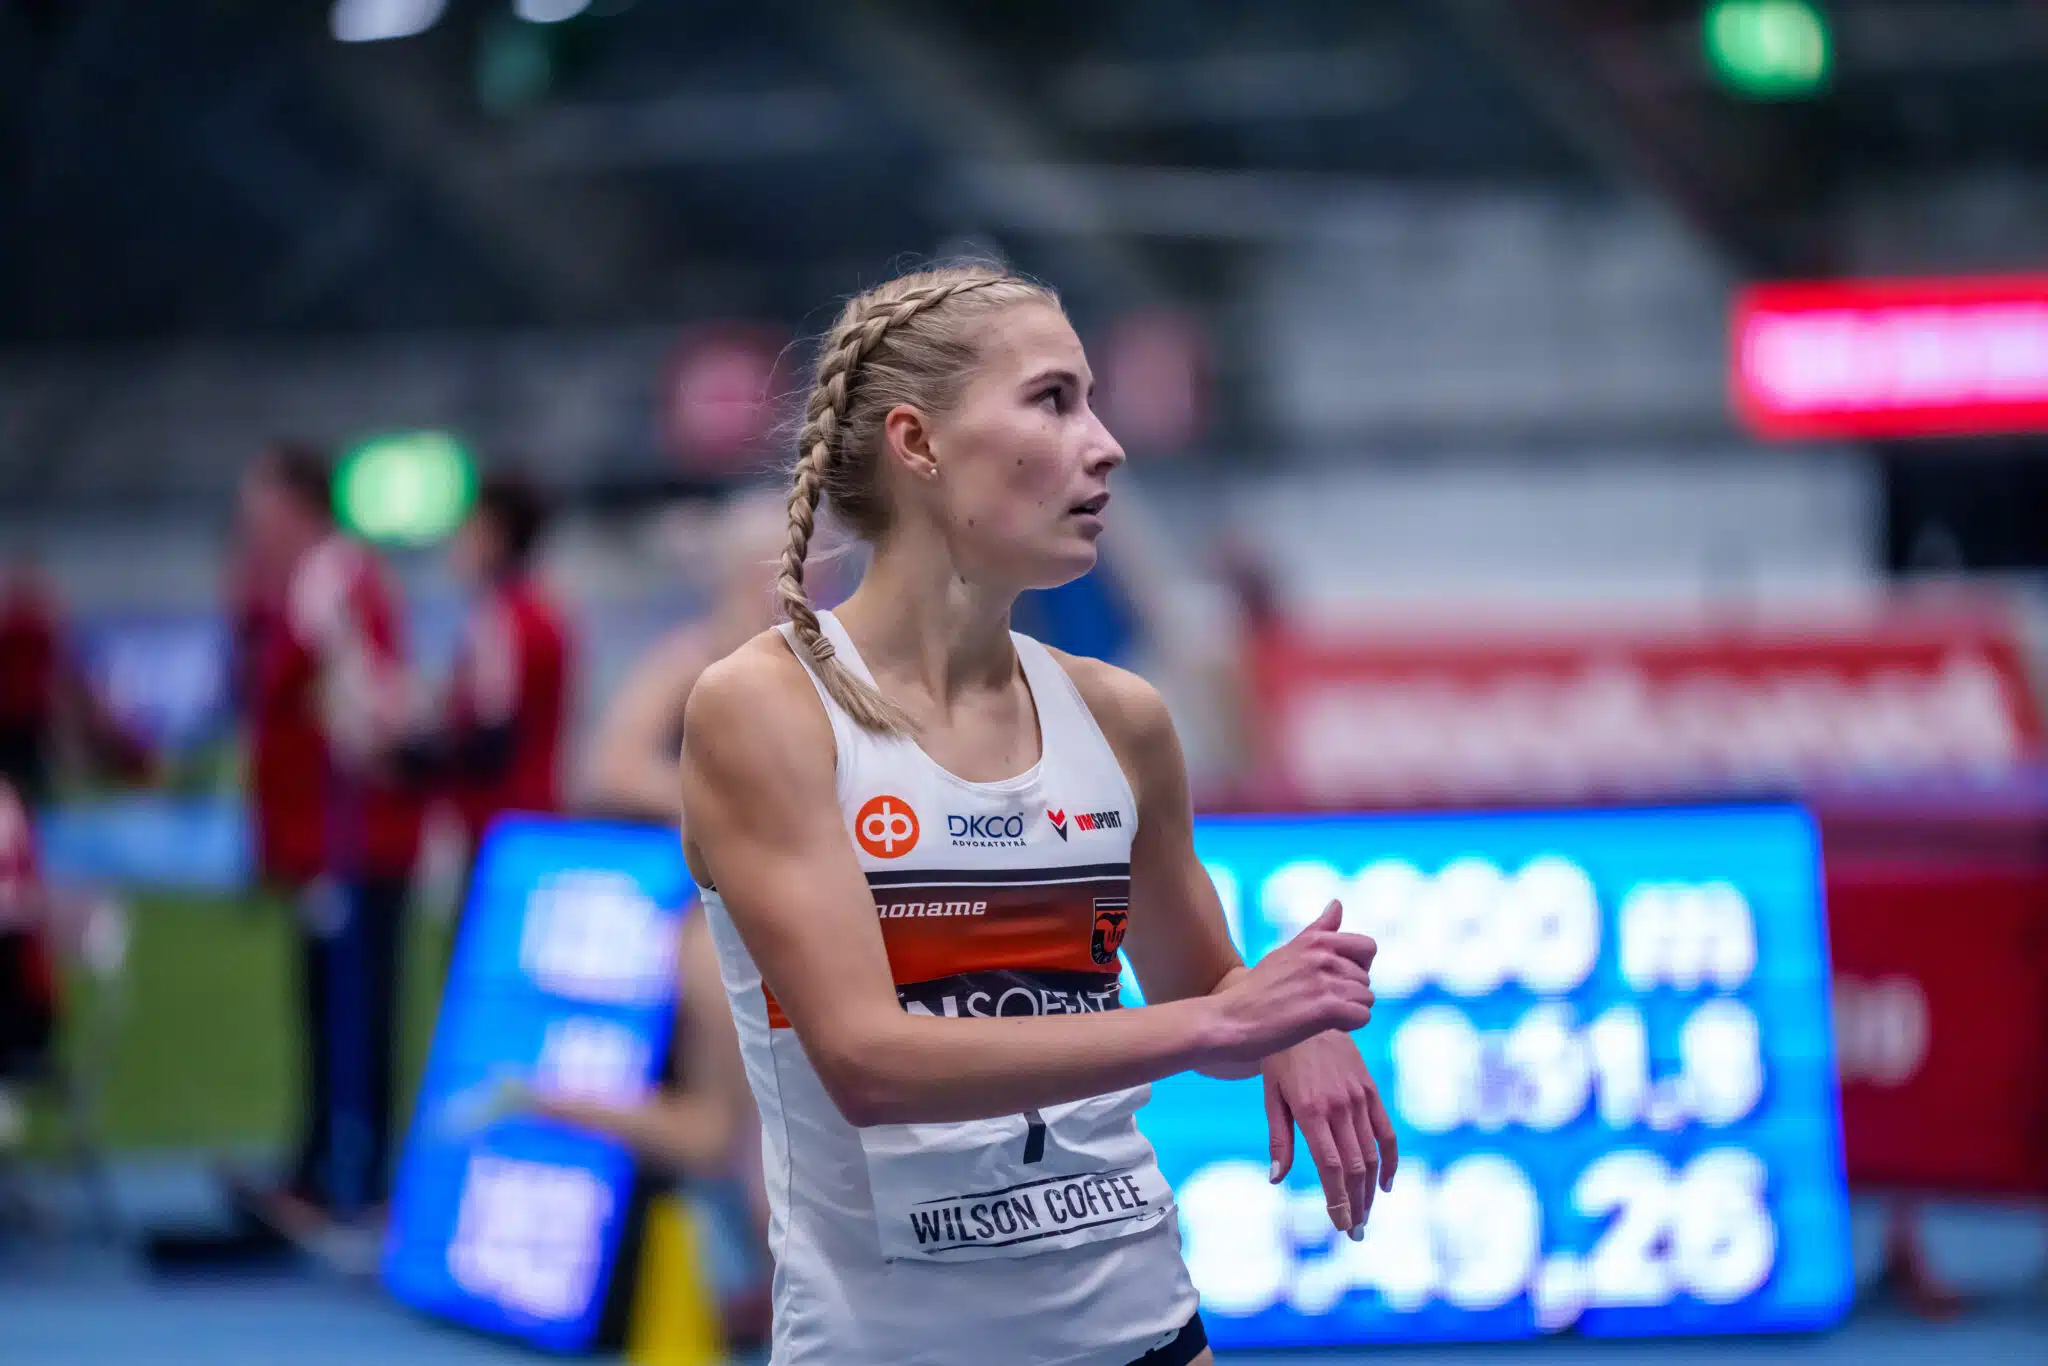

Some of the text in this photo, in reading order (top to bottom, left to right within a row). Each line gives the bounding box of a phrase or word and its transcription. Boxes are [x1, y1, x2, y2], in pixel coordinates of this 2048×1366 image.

[952, 838, 1027, 847] ADVOKATBYRÅ
[876, 901, 988, 918] noname
[909, 1174, 1149, 1245] WILSON COFFEE
